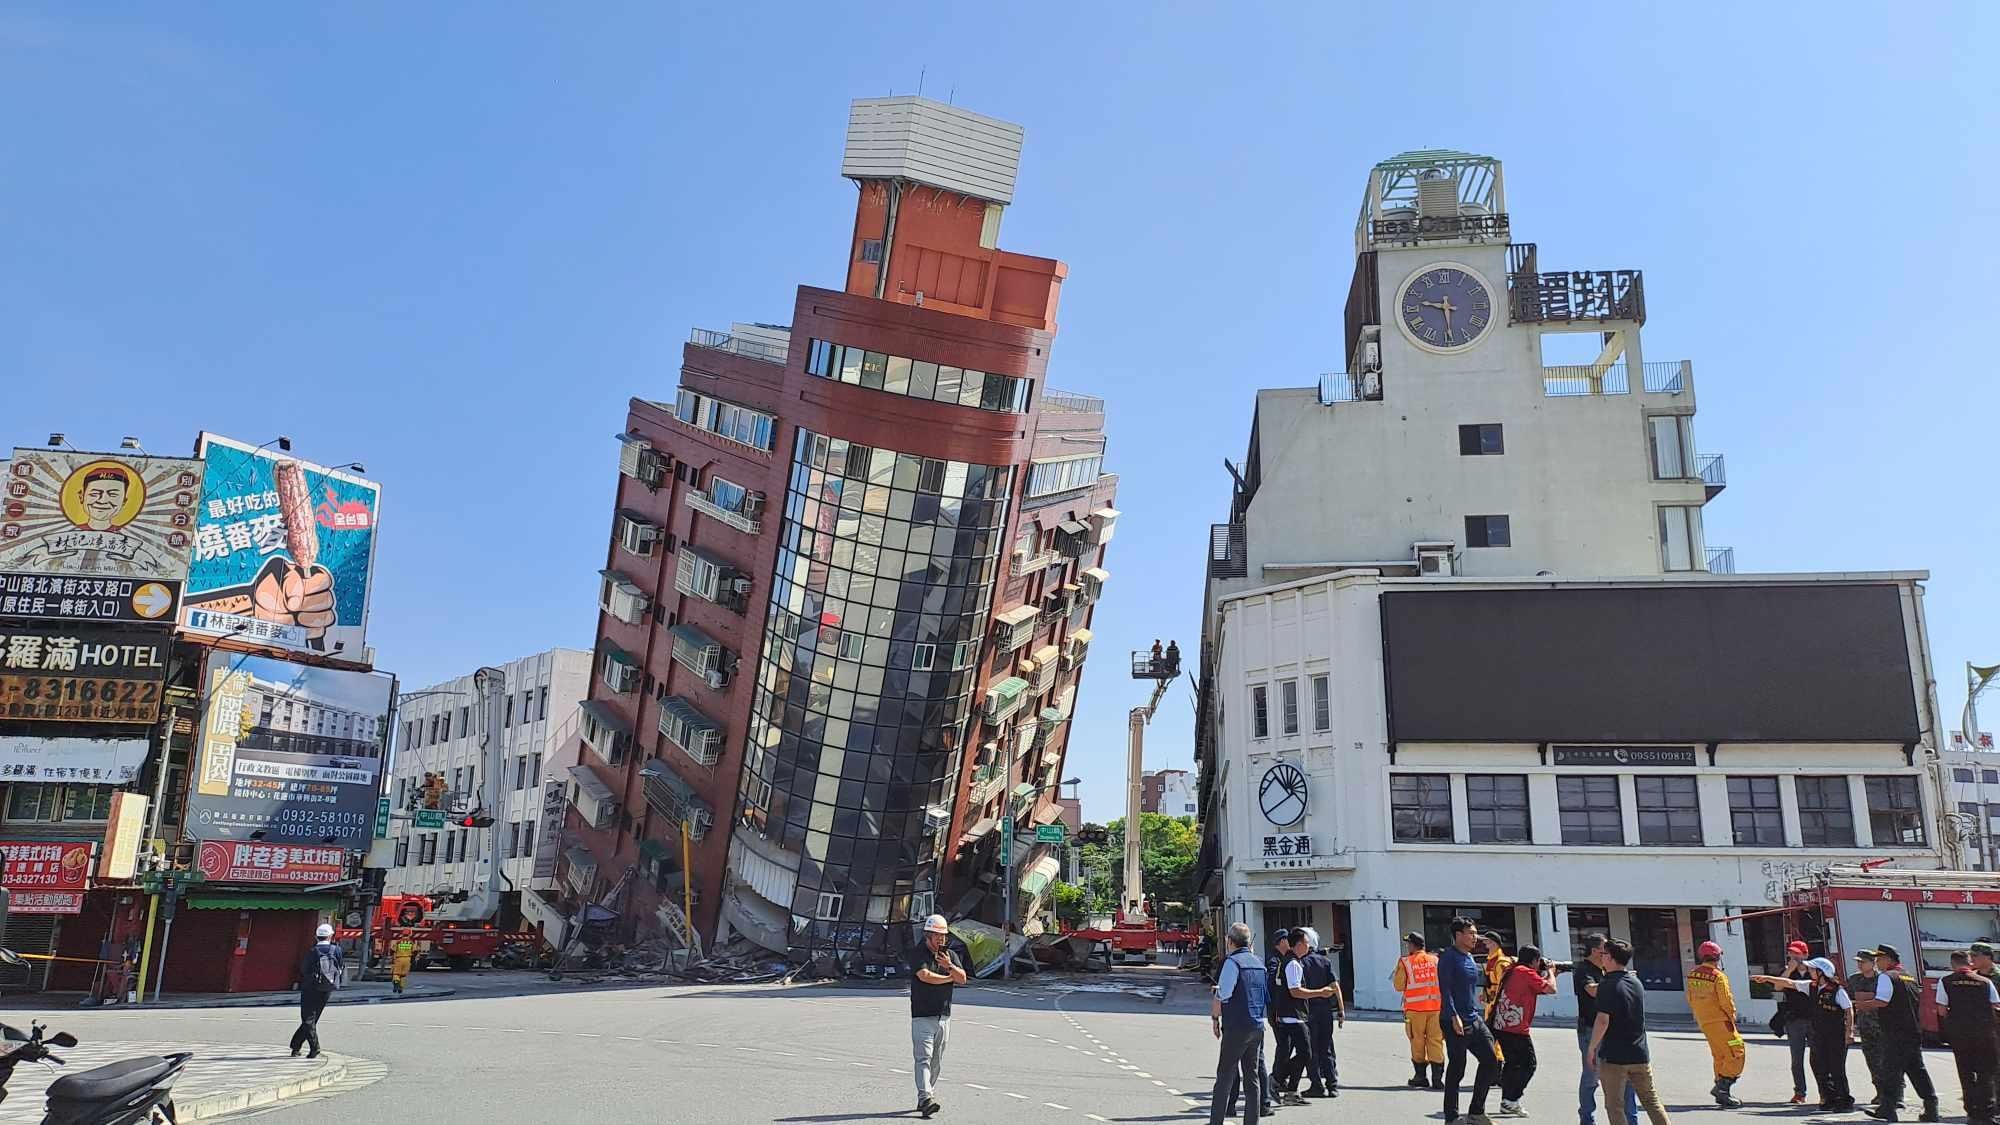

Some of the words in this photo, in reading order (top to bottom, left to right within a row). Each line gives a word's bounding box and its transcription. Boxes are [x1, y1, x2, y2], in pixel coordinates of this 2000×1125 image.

[208, 491, 281, 519] 最好吃的
[193, 513, 289, 561] 燒番麥
[0, 575, 133, 598] 中山路北濱街交叉路口
[209, 615, 284, 639] 林記燒番麥
[80, 644, 163, 668] HOTEL
[0, 678, 157, 704] -8316622
[282, 809, 365, 825] 0932-581018
[280, 823, 362, 839] 0905-935071
[1264, 836, 1310, 856] 黑金通
[2, 874, 57, 884] 03-8327130
[290, 871, 339, 882] 03-8327130
